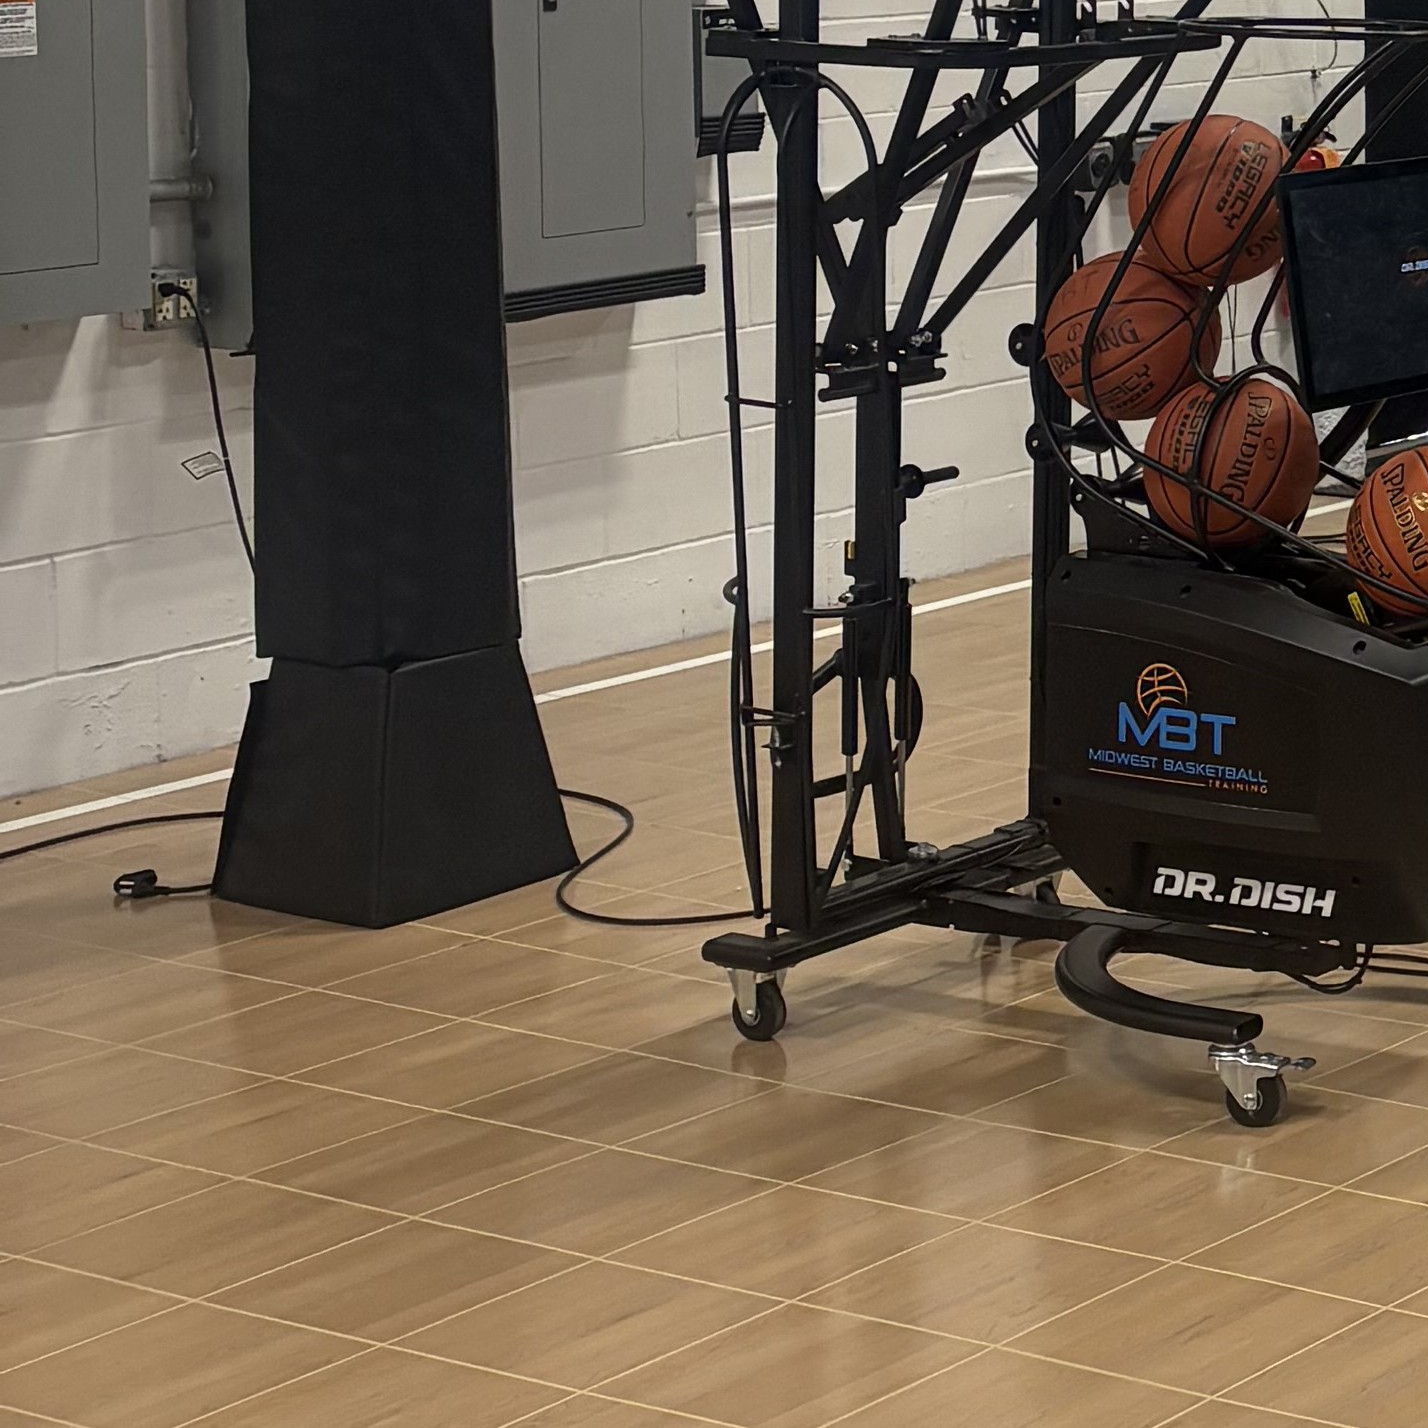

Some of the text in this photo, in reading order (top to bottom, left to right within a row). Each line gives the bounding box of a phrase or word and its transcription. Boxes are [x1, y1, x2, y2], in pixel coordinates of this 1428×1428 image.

[1117, 701, 1237, 756] MBT
[1088, 747, 1268, 783] MIDWEST BASKETBALL
[1208, 779, 1268, 794] TRAINING
